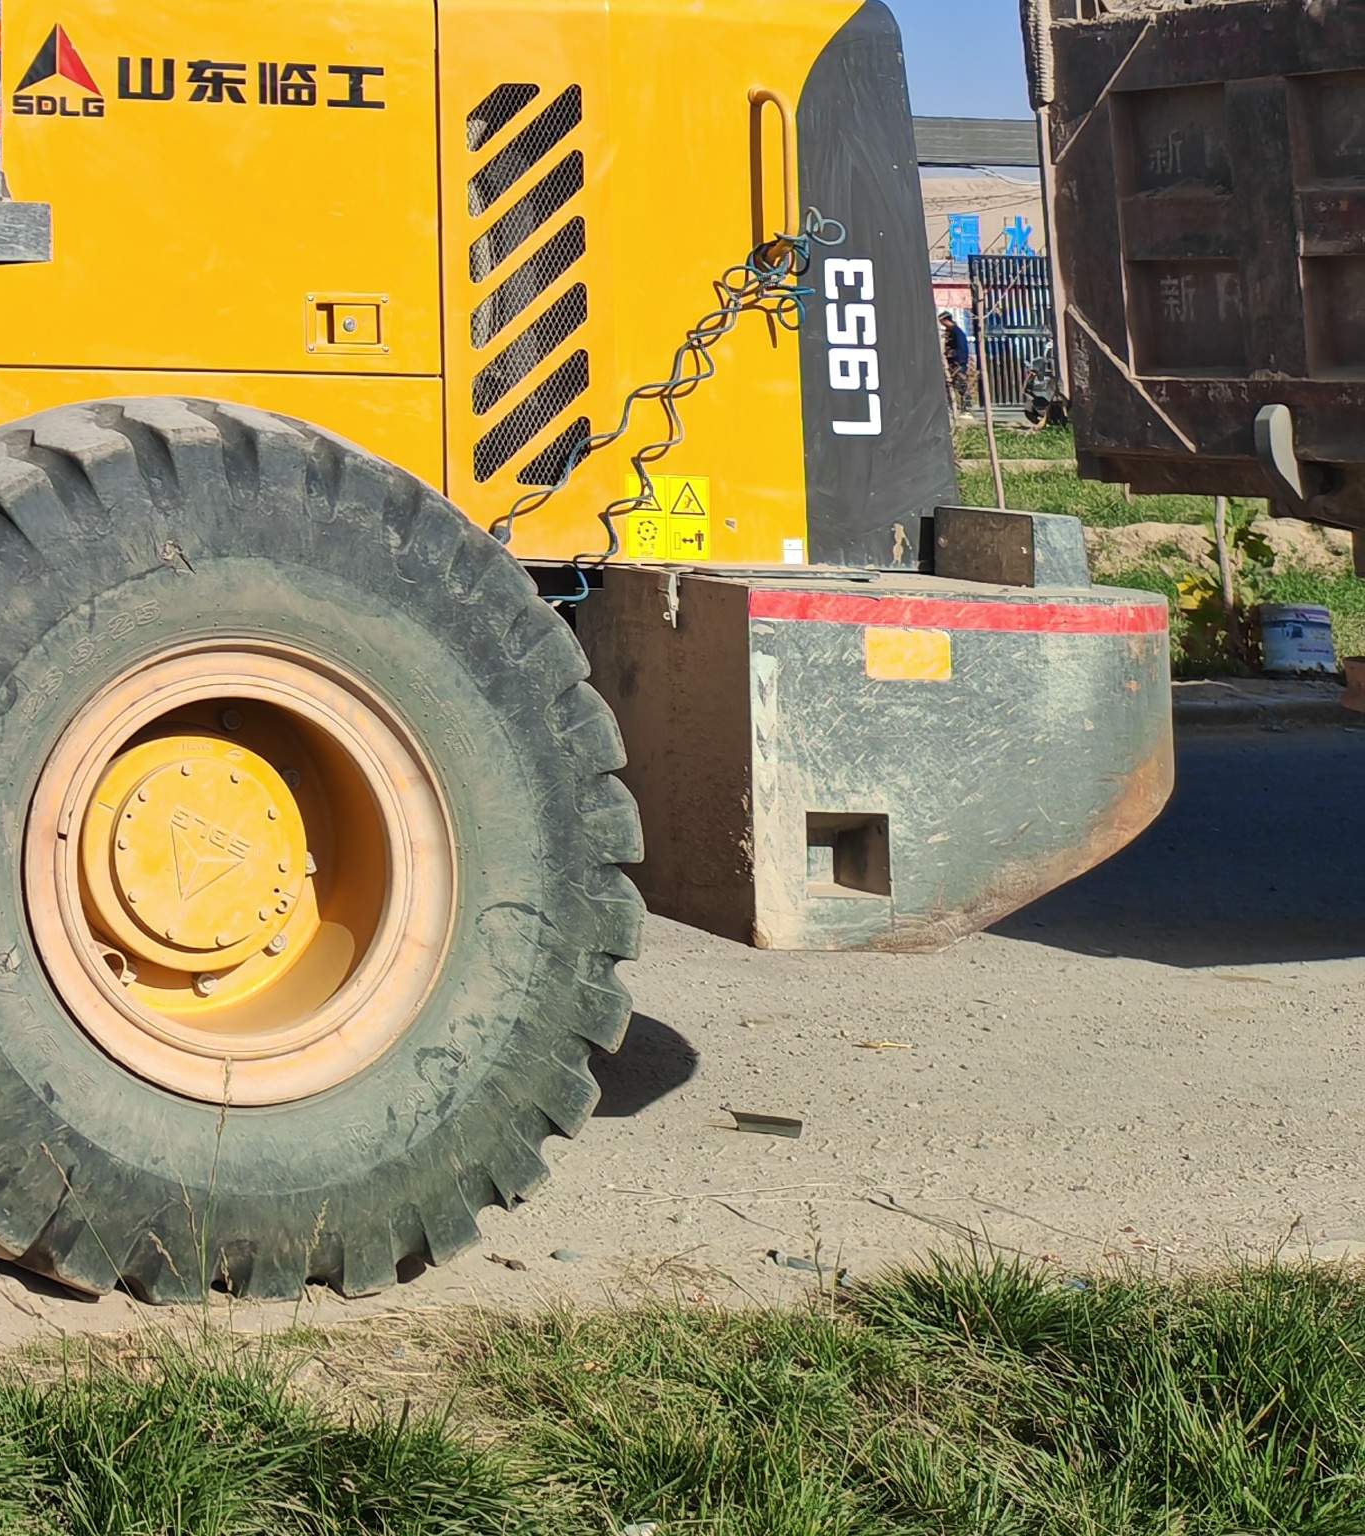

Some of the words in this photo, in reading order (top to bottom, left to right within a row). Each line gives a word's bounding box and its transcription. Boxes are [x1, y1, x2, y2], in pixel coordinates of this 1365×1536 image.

[11, 95, 105, 118] SDLG
[117, 56, 386, 110] 山东临工
[824, 257, 883, 437] L953
